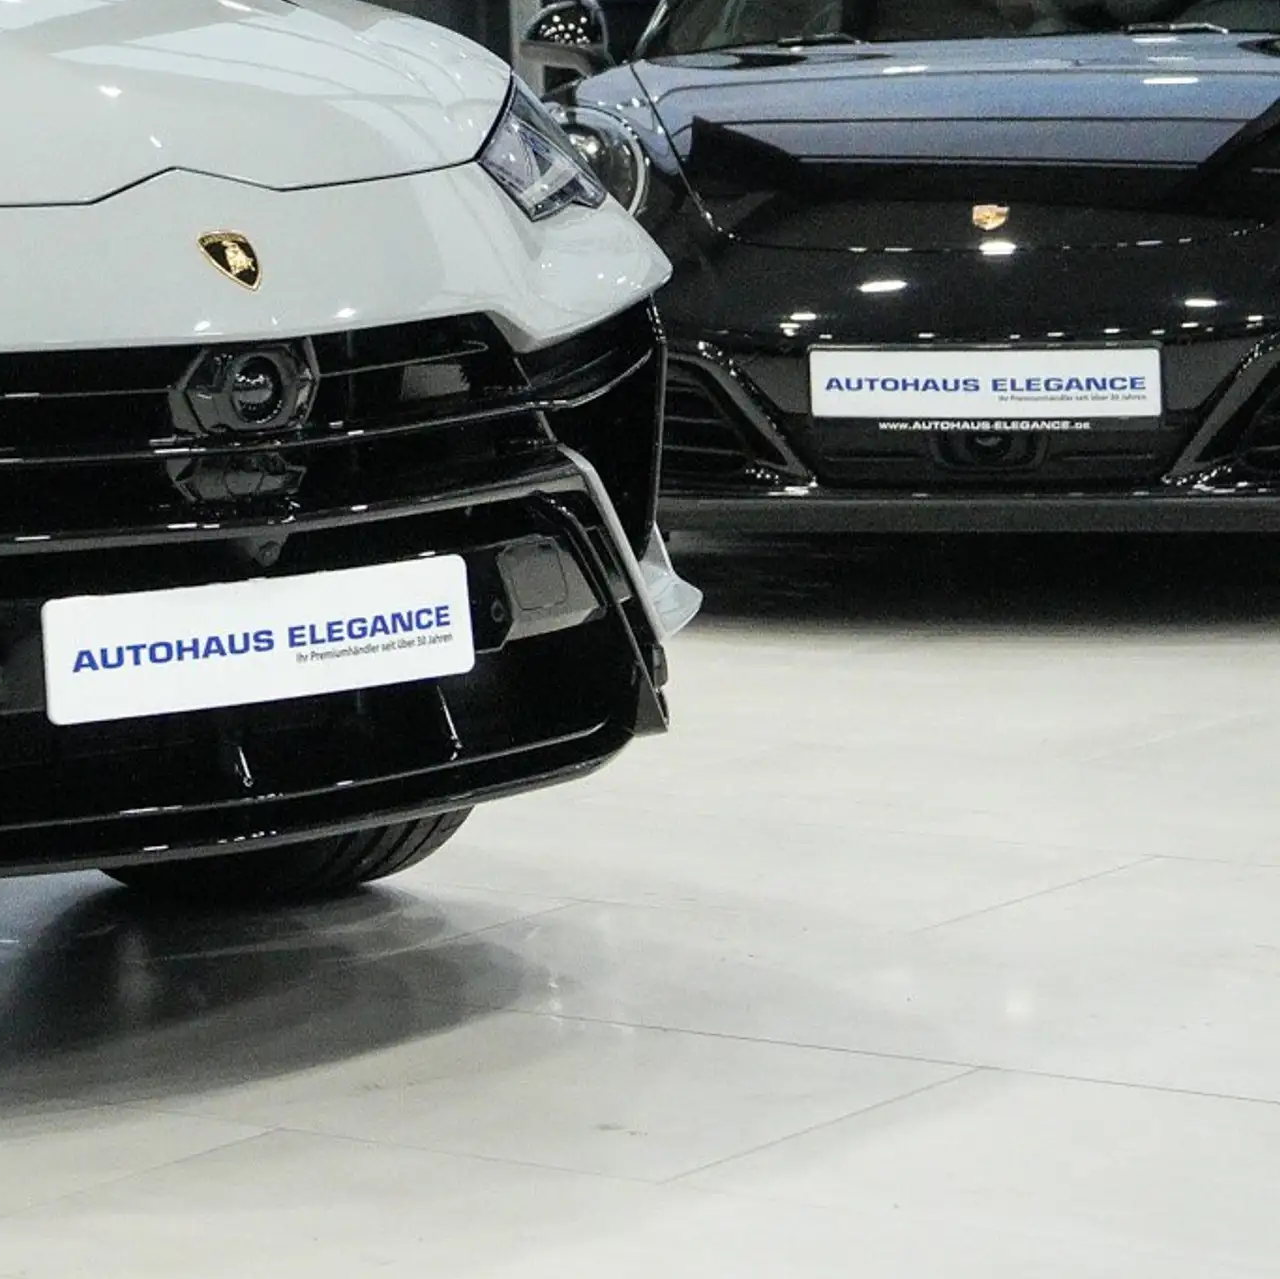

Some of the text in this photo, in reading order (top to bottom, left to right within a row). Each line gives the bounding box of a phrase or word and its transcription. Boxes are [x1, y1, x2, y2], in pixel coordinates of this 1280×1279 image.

[825, 376, 1146, 392] AUTOHAUS ELEGANCE
[72, 604, 451, 673] AUTOHAUS ELEGANCE
[295, 651, 309, 664] Ihr
[310, 643, 379, 661] Premiumhändler
[381, 640, 397, 652] seit
[397, 638, 416, 649] über
[428, 633, 453, 645] Jahren
